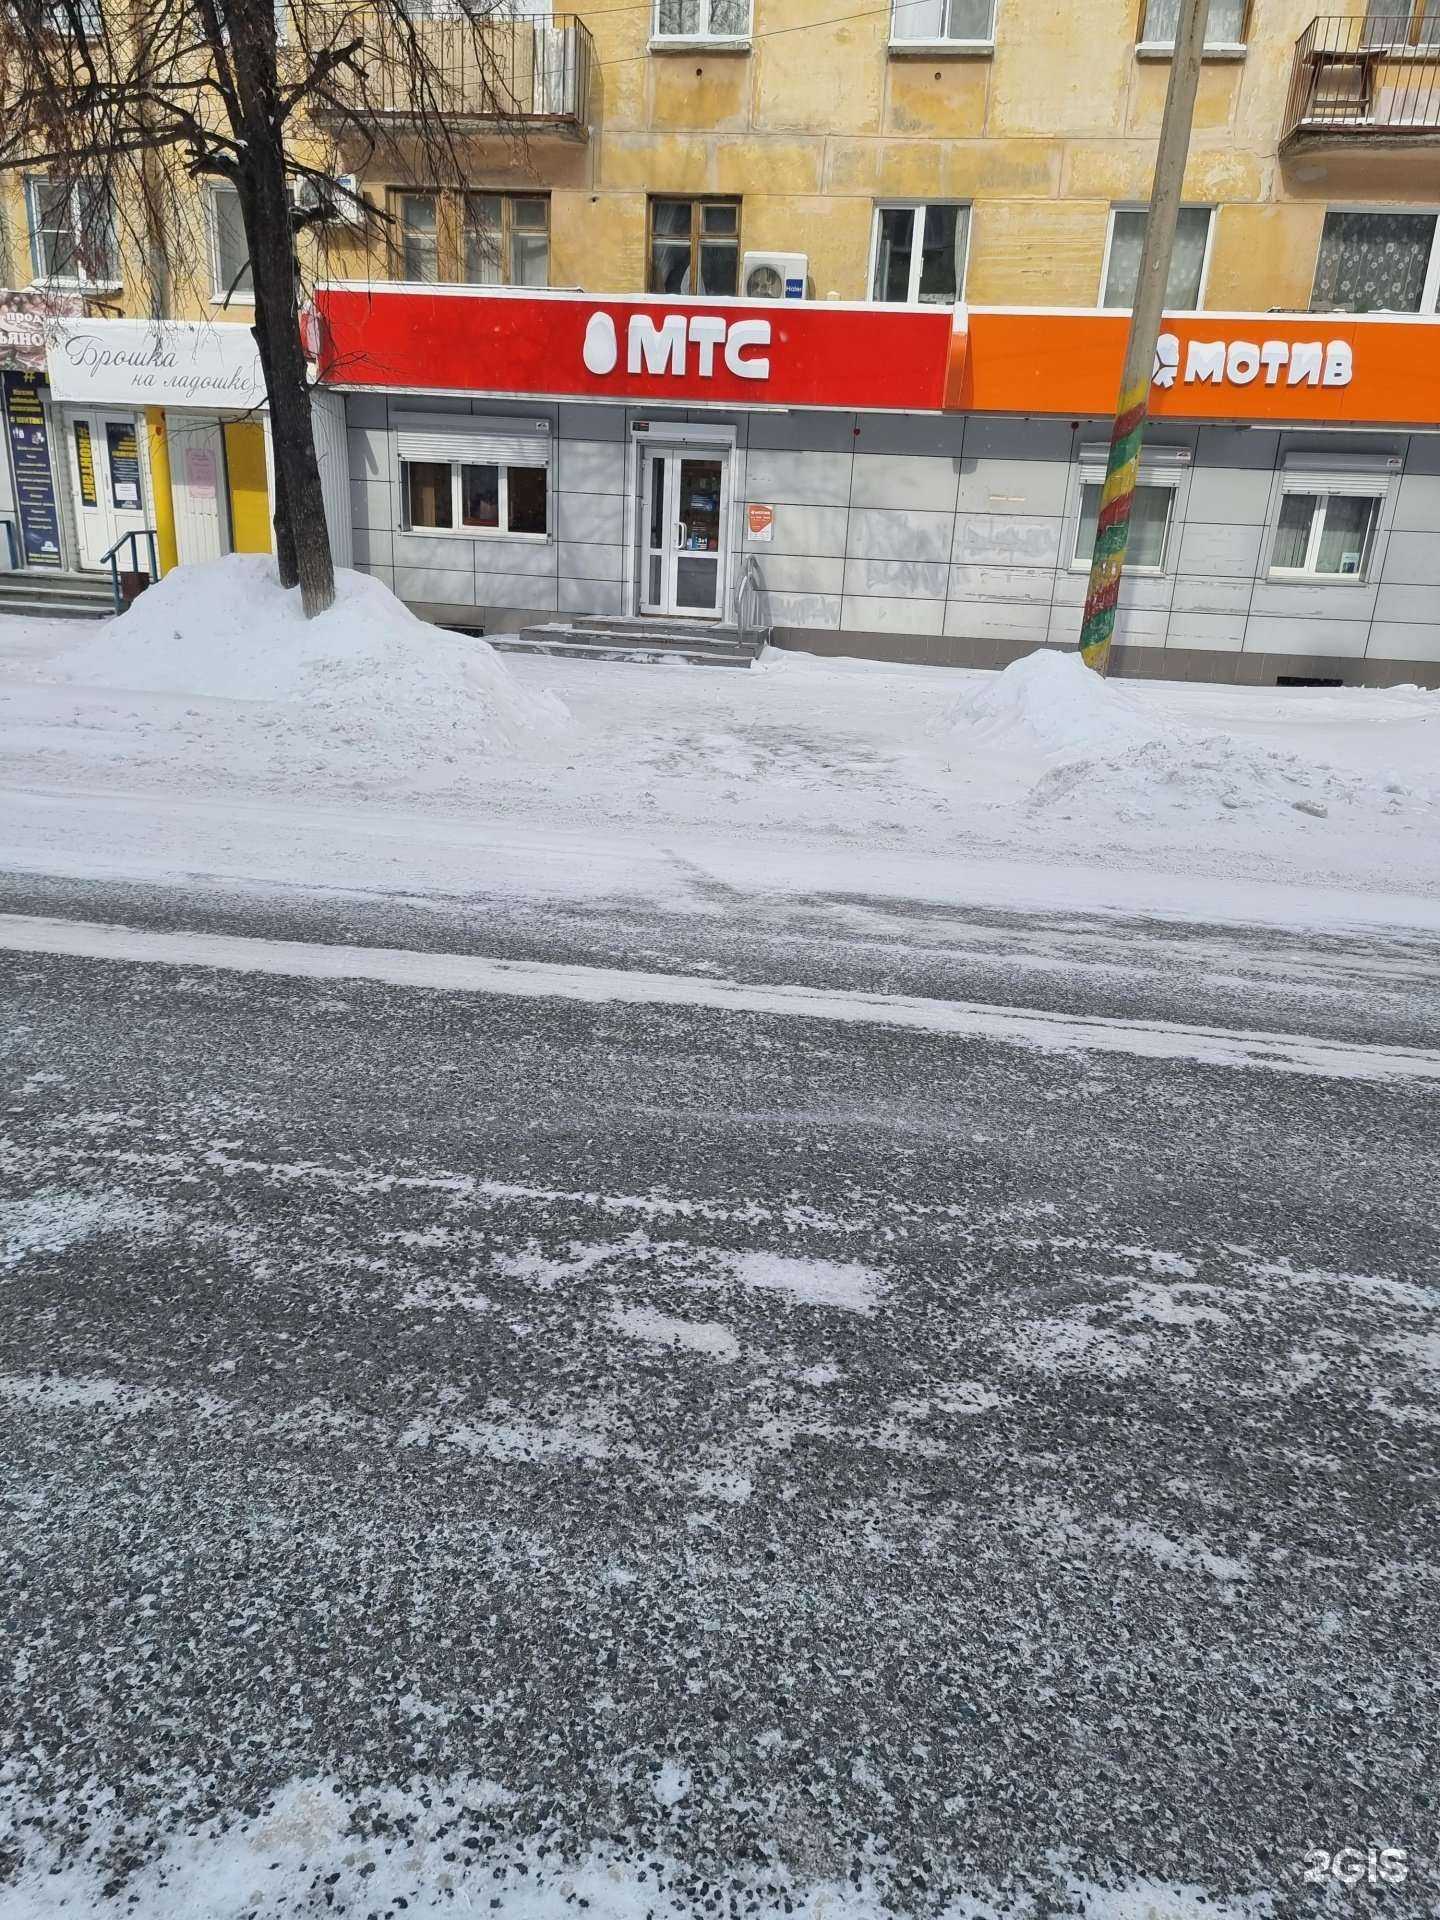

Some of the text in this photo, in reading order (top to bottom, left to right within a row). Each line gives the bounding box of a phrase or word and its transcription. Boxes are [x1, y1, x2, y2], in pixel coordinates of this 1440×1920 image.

[65, 335, 178, 378] Брошка
[627, 313, 771, 379] МТС
[1184, 339, 1353, 387] МОТИВ
[131, 365, 250, 399] на ладошке
